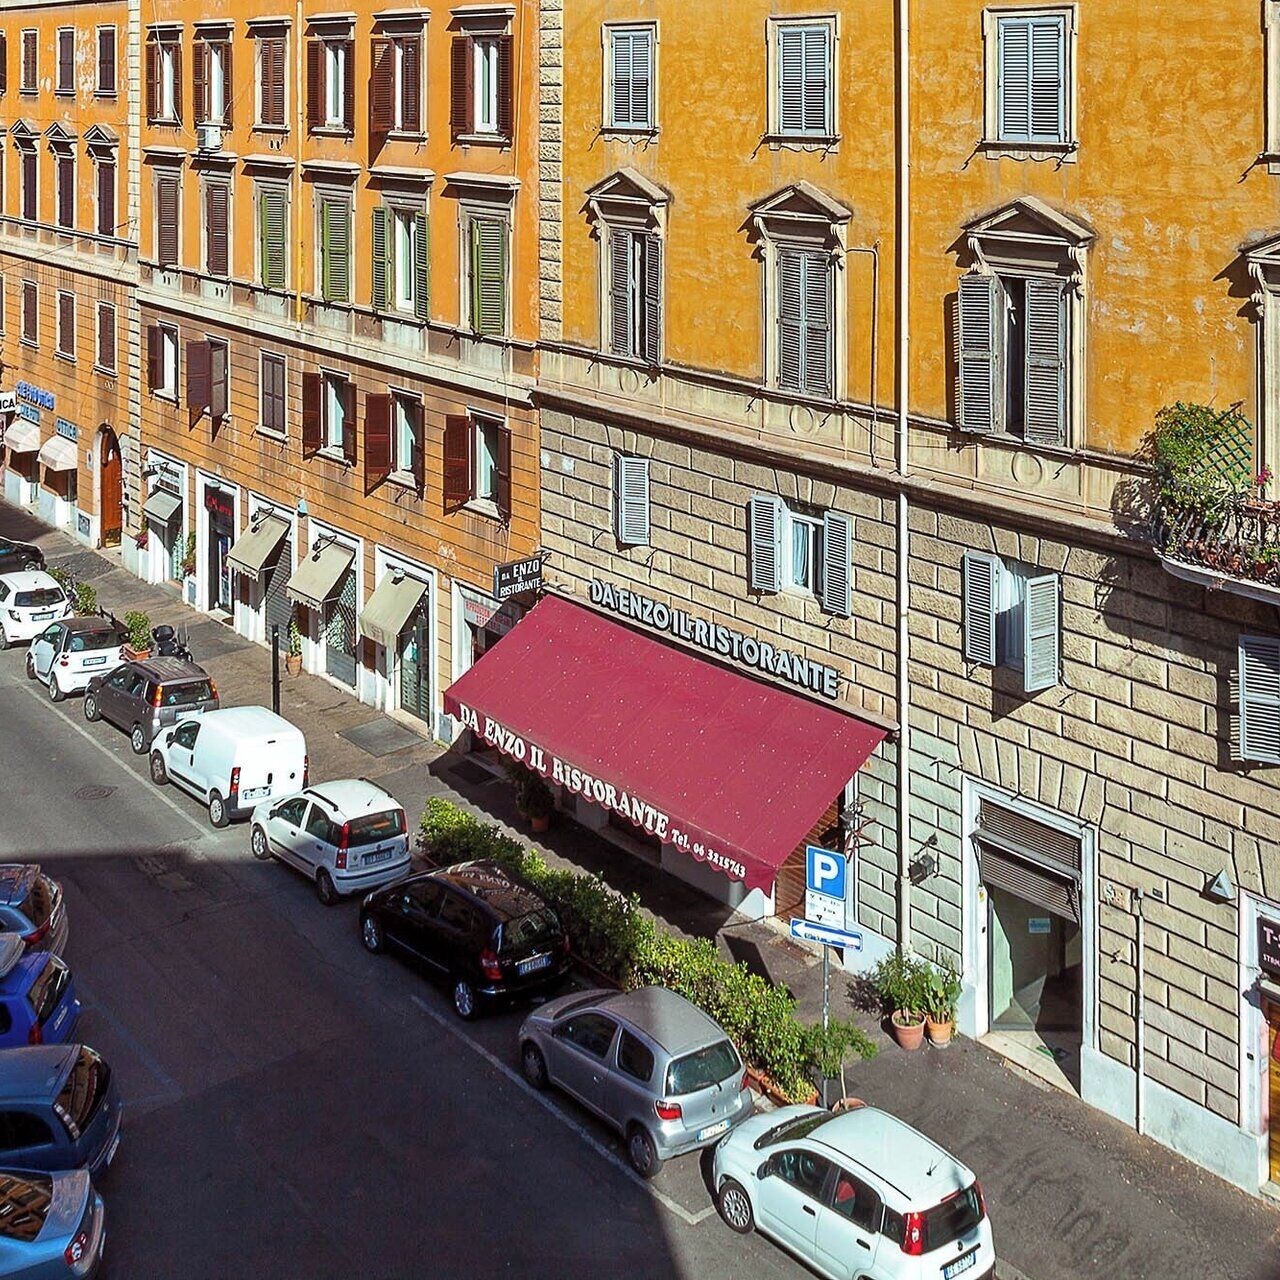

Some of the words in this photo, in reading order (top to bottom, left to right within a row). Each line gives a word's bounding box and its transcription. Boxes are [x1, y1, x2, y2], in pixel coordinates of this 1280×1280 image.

[500, 577, 541, 597] RISTORANTE
[501, 572, 510, 580] DA
[513, 559, 540, 578] ENZO
[591, 581, 616, 609] DA
[619, 591, 670, 630] ENZO
[672, 610, 691, 638] IL
[693, 622, 839, 698] RISTORANTE
[459, 703, 480, 732] DA
[484, 717, 526, 759] ENZO
[529, 746, 547, 773] IL
[552, 756, 670, 839] RISTORANTE
[671, 829, 691, 849] Tel.
[693, 843, 705, 857] 06
[706, 849, 746, 878] 3215743
[813, 852, 839, 889] P
